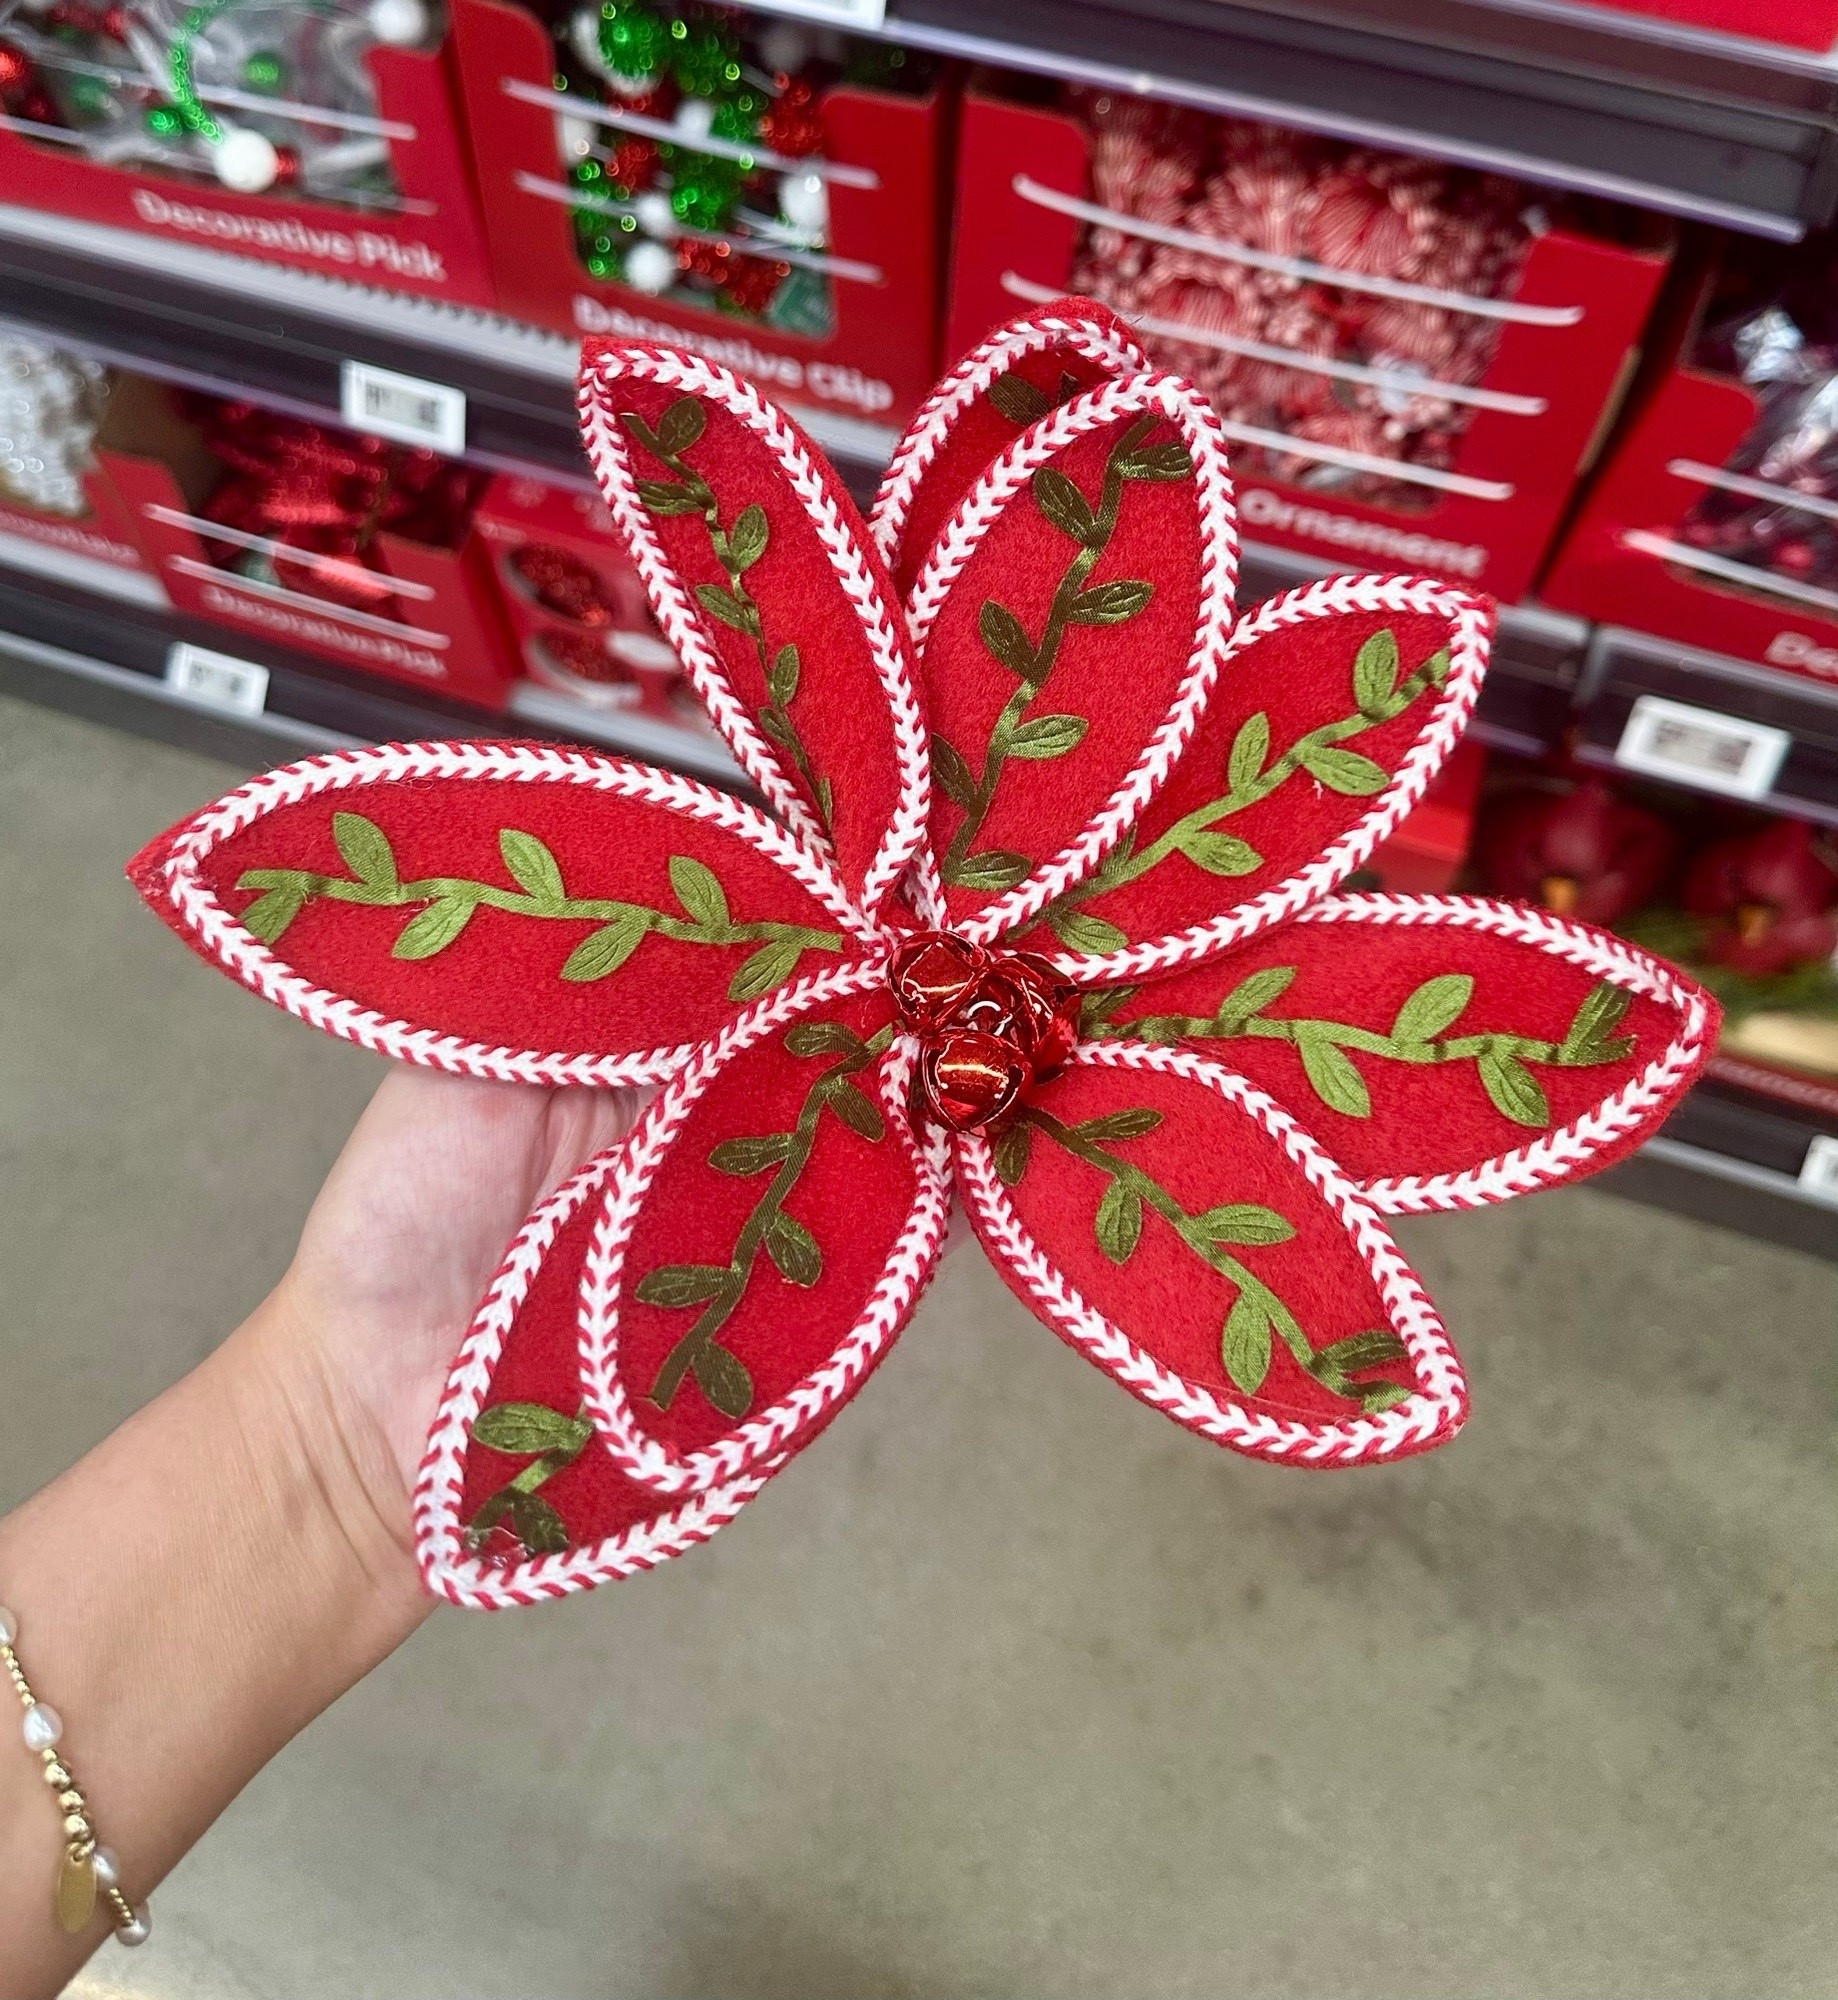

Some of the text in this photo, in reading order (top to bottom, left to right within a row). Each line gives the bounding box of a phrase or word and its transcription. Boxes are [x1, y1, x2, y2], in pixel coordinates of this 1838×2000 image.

[132, 190, 447, 281] Decorative Pick
[806, 362, 894, 412] Clip
[1239, 489, 1488, 577] Ornament
